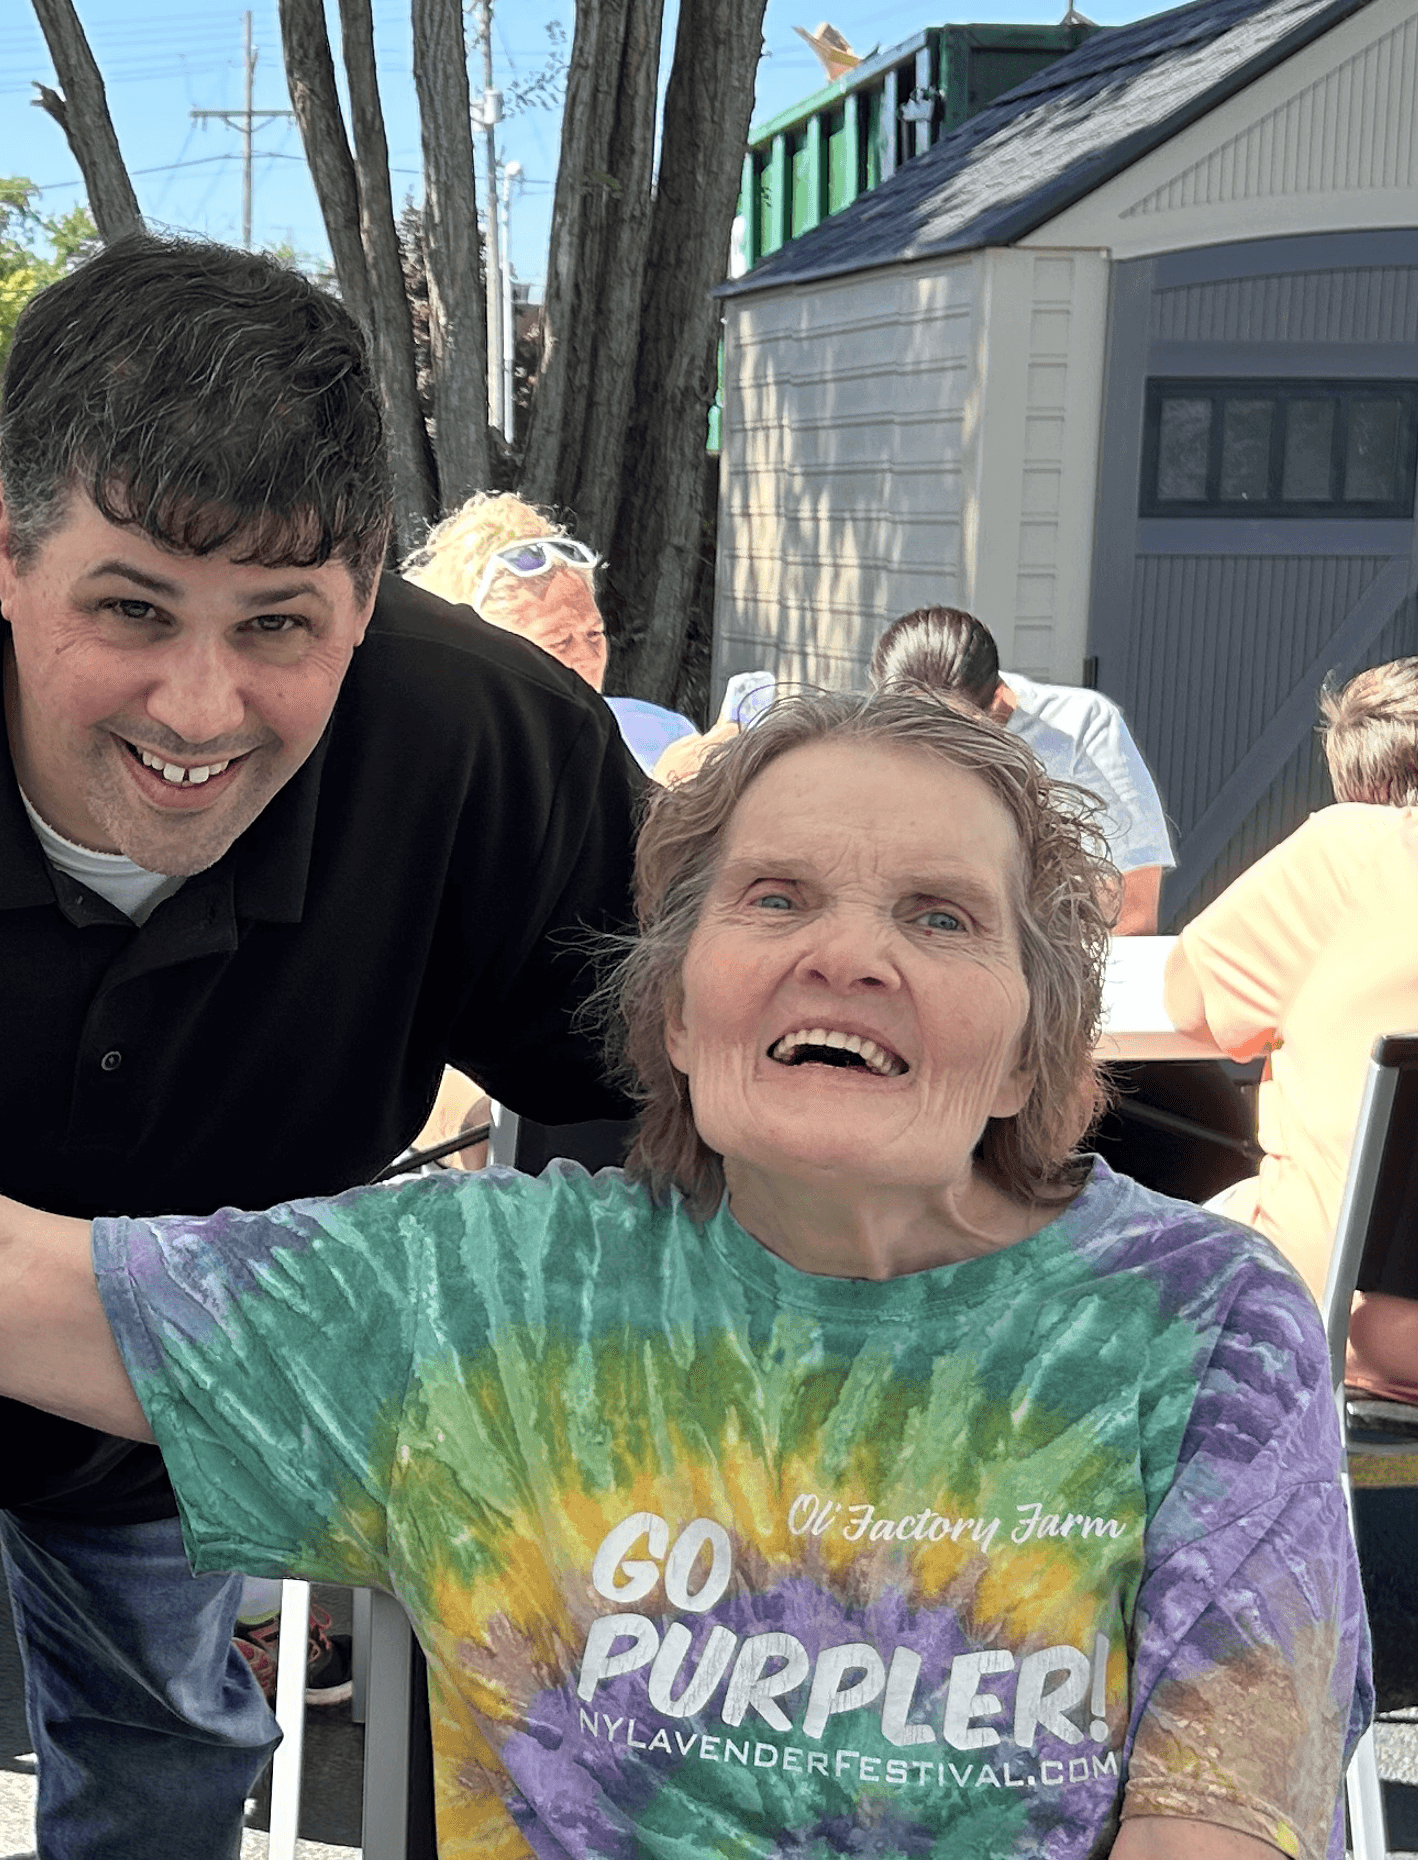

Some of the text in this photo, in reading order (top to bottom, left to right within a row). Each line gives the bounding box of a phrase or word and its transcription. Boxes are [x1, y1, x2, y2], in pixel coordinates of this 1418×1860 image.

[592, 1511, 732, 1613] GO
[843, 1504, 1000, 1553] Factory
[1011, 1502, 1126, 1543] Farm
[577, 1612, 1111, 1751] PURPLER!
[580, 1708, 1120, 1788] NYLAVENDERFESTIVAL.COM
